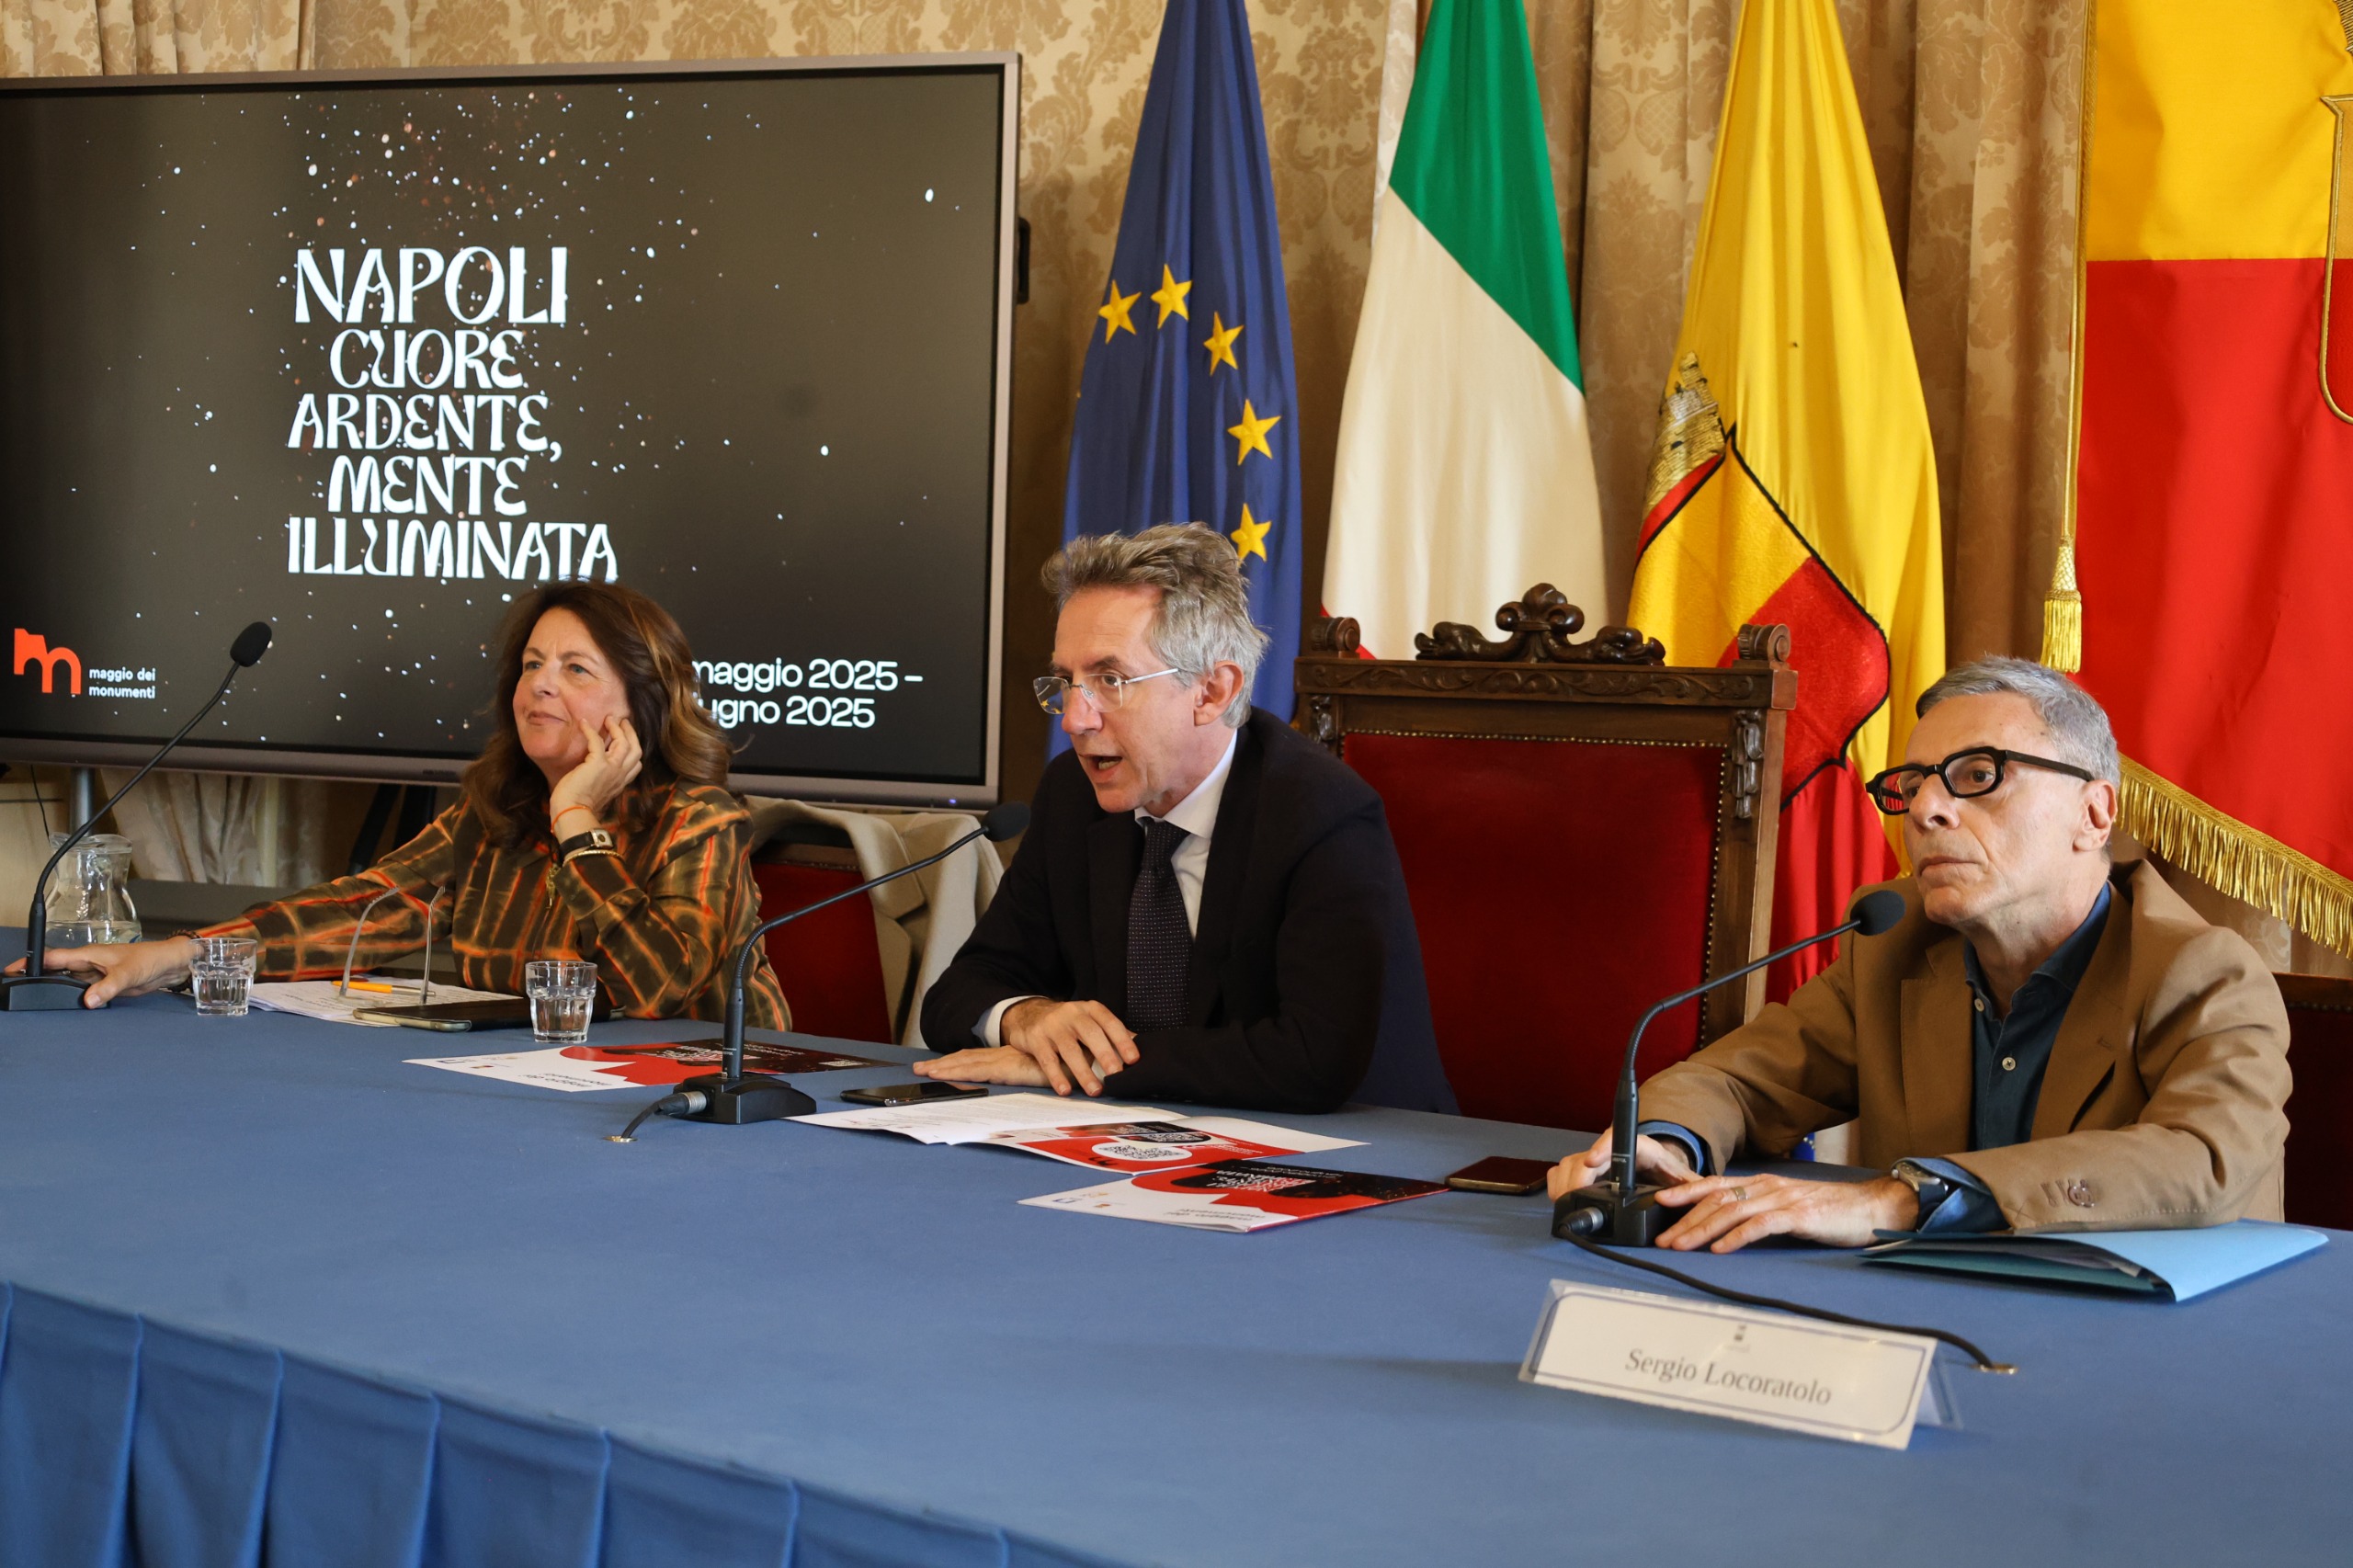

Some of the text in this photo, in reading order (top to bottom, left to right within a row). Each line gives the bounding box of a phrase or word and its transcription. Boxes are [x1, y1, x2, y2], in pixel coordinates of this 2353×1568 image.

[294, 245, 568, 324] NAPOLI
[329, 328, 525, 390] CUORE
[287, 393, 563, 462] ARDENTE,
[327, 455, 527, 517] MENTE
[288, 517, 618, 584] ILLUMINATA
[88, 686, 156, 699] monumenti
[89, 666, 156, 683] maggio dei
[808, 658, 899, 691] 2025
[786, 695, 876, 729] 2025
[1624, 1347, 1833, 1406] Sergio Locoratolo
